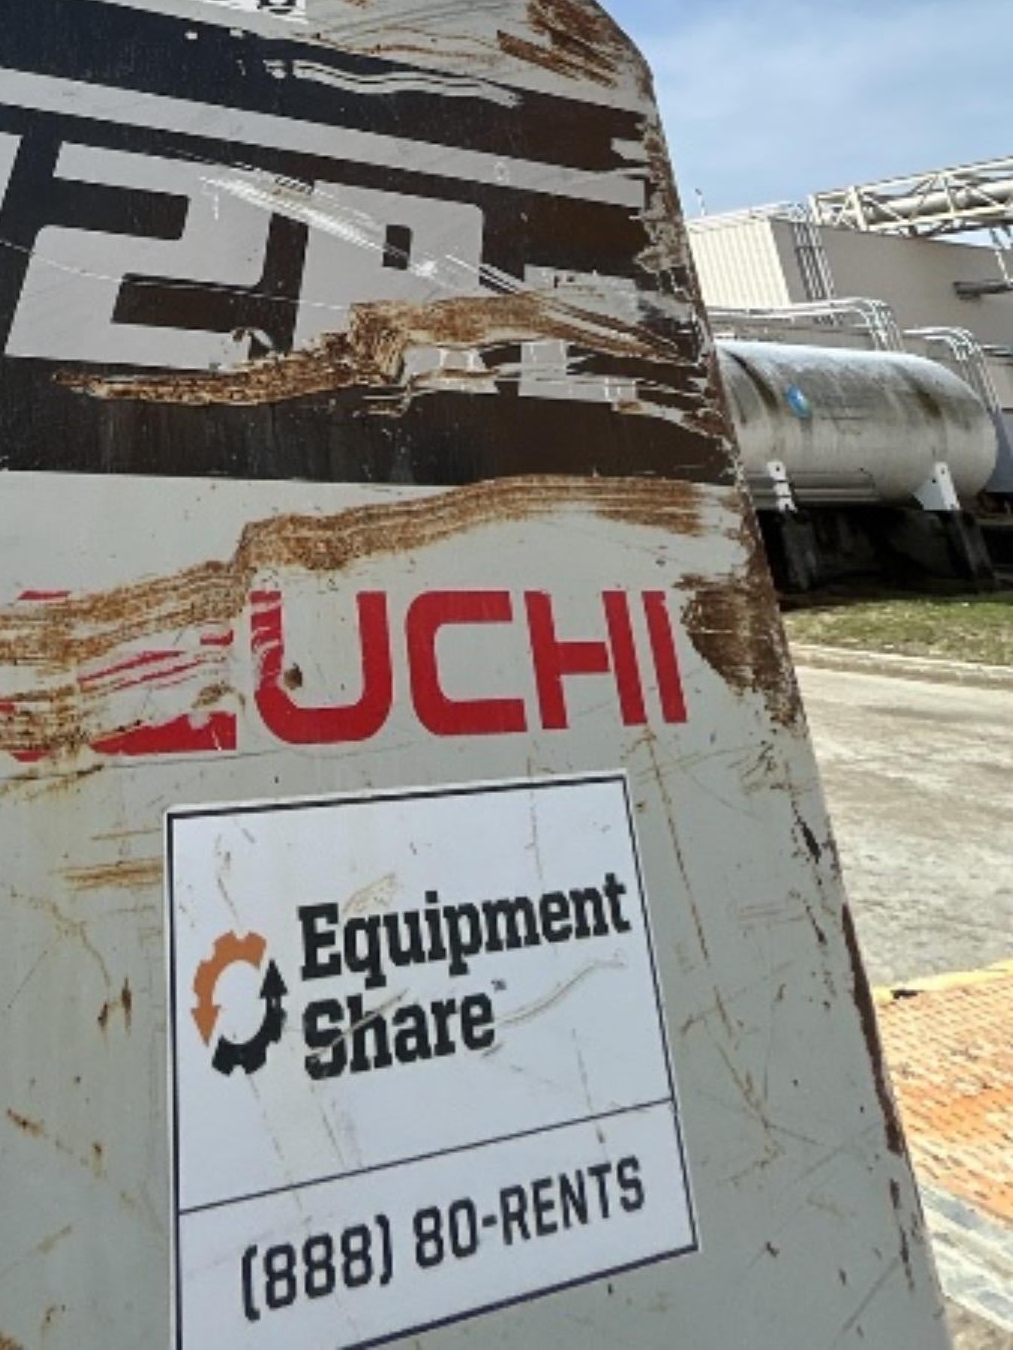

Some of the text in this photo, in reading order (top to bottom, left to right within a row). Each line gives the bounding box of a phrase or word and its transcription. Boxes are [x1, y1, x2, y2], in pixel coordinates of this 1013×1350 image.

[298, 872, 633, 989] Equipment
[304, 991, 495, 1081] Share
[240, 1154, 646, 1323] (888) 80-RENTS
